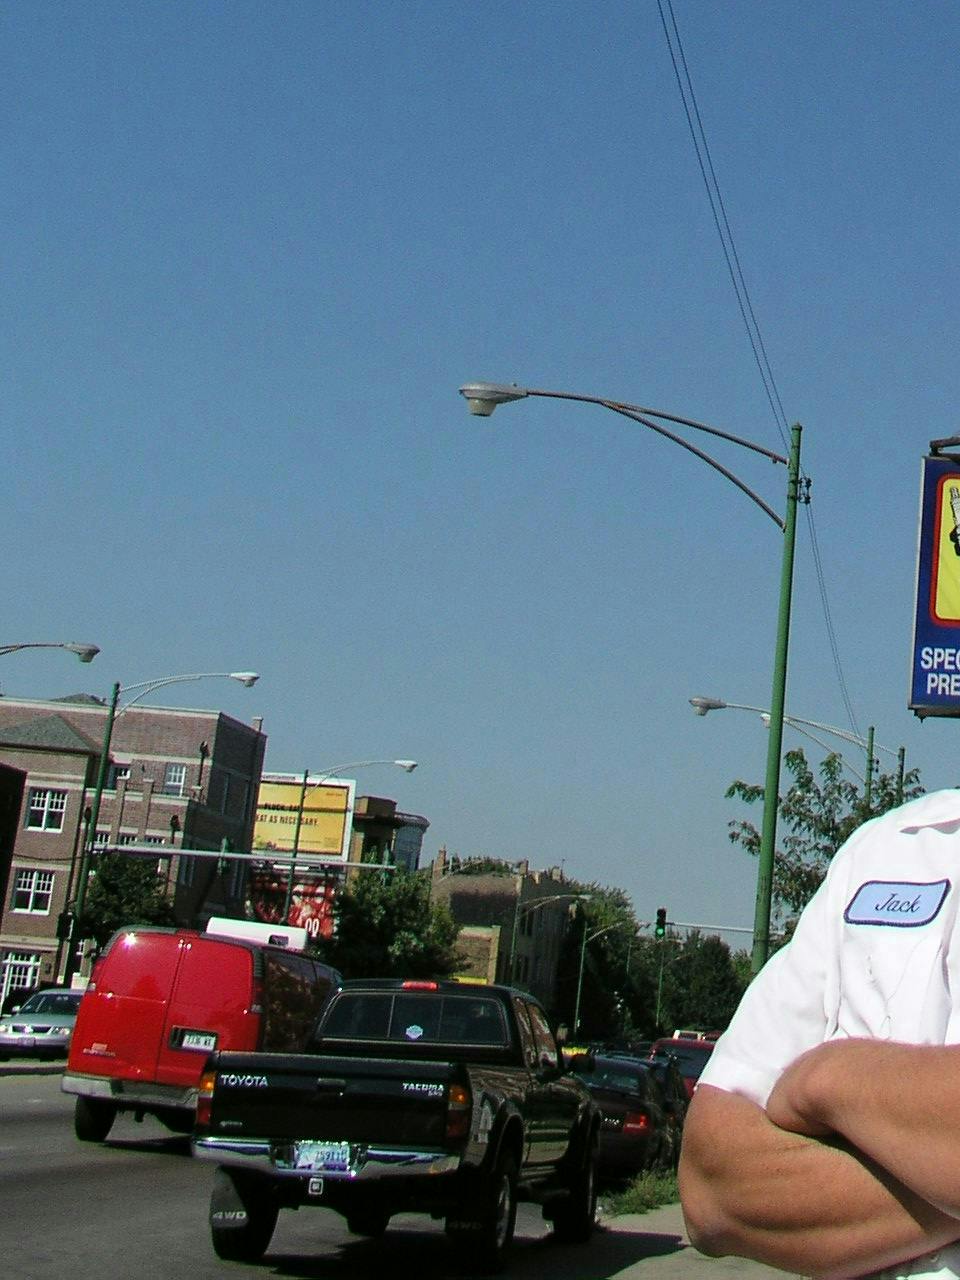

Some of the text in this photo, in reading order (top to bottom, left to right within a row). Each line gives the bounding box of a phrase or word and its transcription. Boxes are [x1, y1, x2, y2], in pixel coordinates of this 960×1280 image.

[874, 892, 922, 913] Jack
[220, 1074, 269, 1087] TOYOTA
[212, 1210, 248, 1220] 4WD
